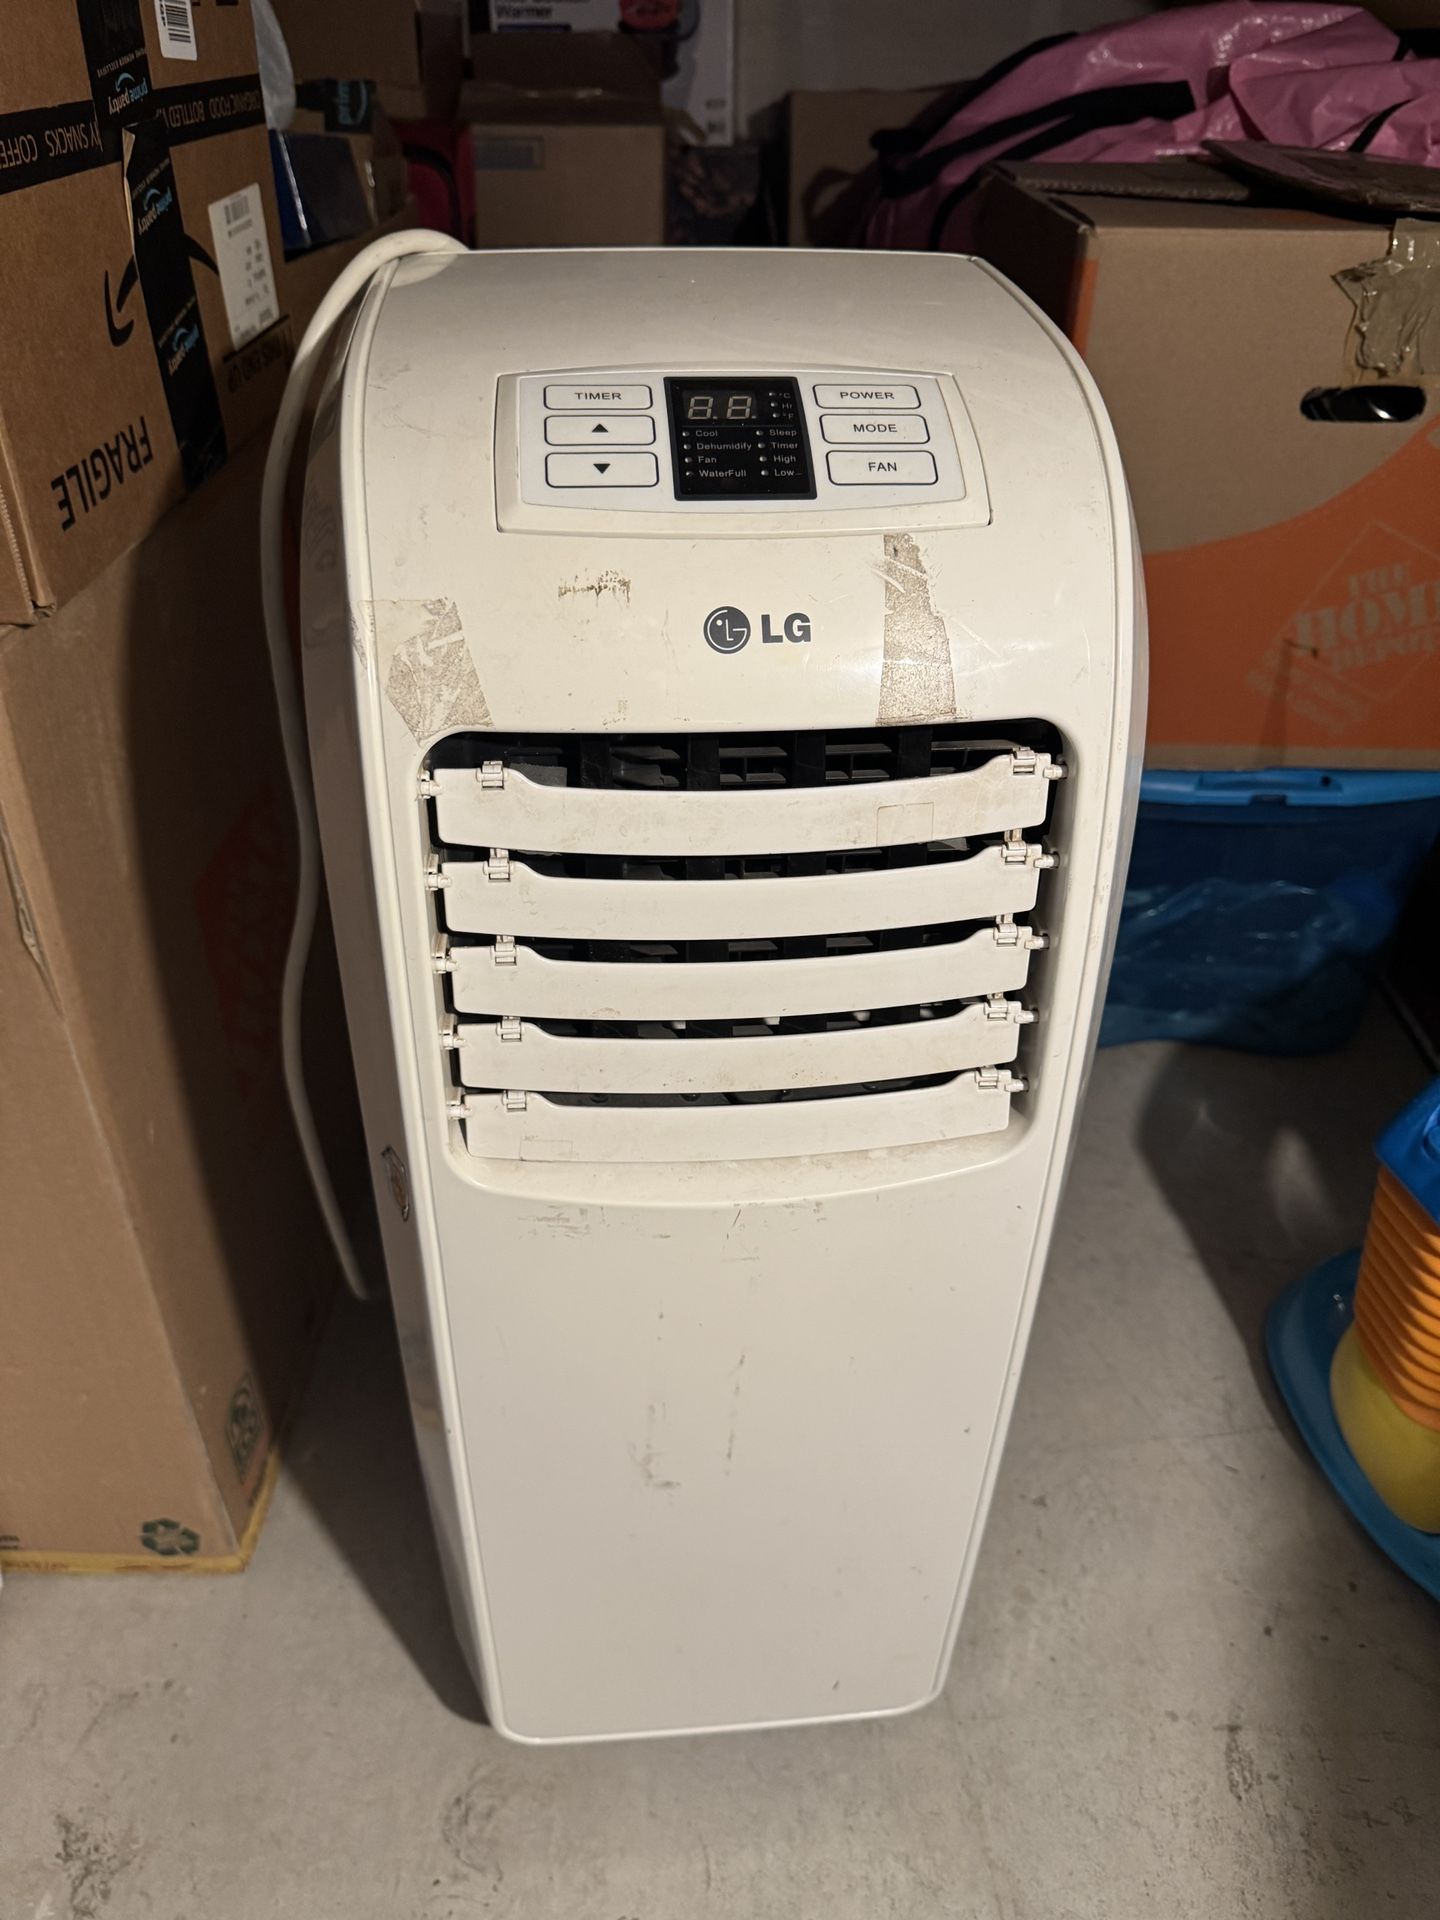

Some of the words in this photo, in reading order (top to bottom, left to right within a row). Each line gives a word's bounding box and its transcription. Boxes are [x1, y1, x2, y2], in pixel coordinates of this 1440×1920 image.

[208, 94, 231, 119] FOOD
[168, 100, 206, 128] BOTTLED
[47, 121, 90, 157] SNACKS
[0, 132, 38, 170] COFFE
[574, 391, 622, 401] TIMER
[839, 390, 895, 400] POWER
[768, 428, 798, 438] Sleep
[853, 422, 898, 433] MODE
[695, 430, 718, 438] Cool
[696, 441, 752, 452] Dehumidify
[770, 441, 799, 450] Timer
[697, 455, 717, 464] Fan
[773, 454, 797, 465] High
[868, 461, 897, 473] FAN
[51, 415, 153, 532] FRAGILE
[698, 469, 747, 478] WaterFull
[774, 469, 795, 478] Low
[1346, 561, 1412, 597] THE
[761, 612, 812, 644] LG
